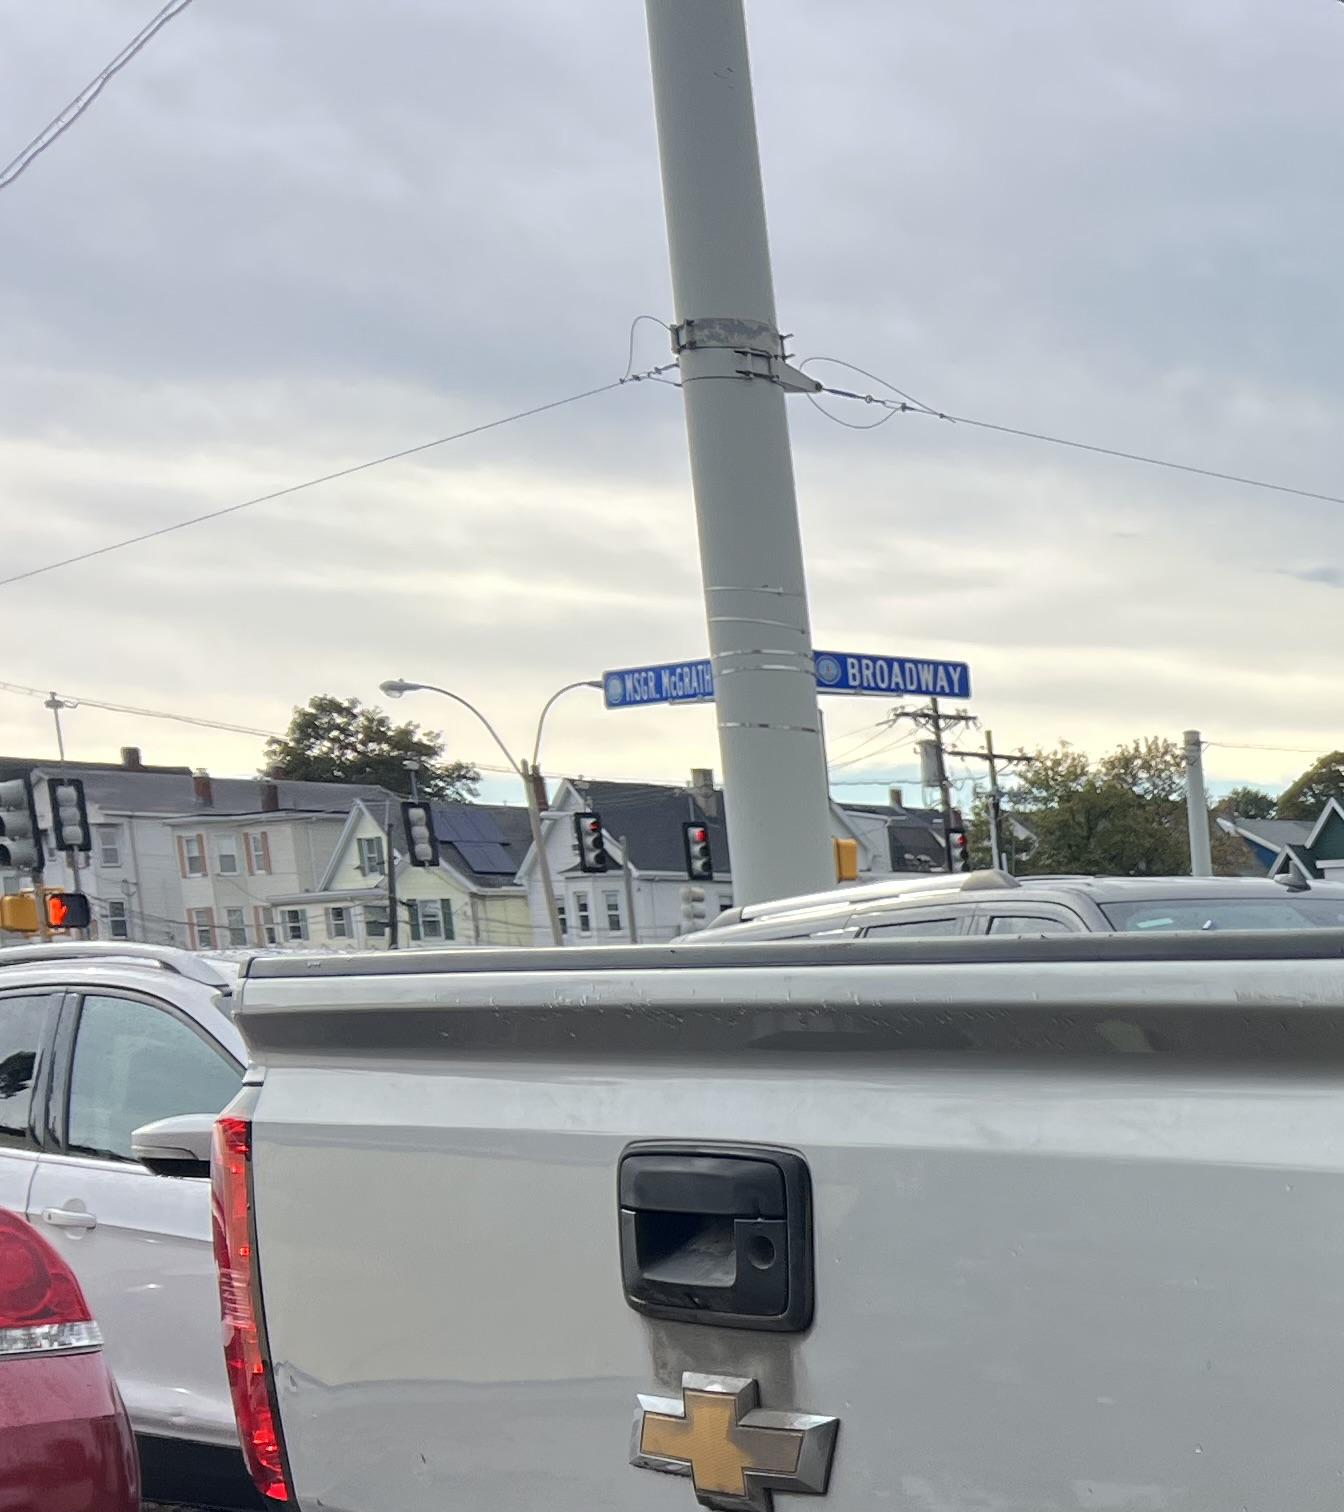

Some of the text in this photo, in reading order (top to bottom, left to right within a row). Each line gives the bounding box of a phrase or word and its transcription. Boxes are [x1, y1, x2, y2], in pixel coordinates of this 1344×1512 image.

[624, 664, 713, 701] MSGR. McGRATH
[847, 656, 962, 694] BROADWAY
